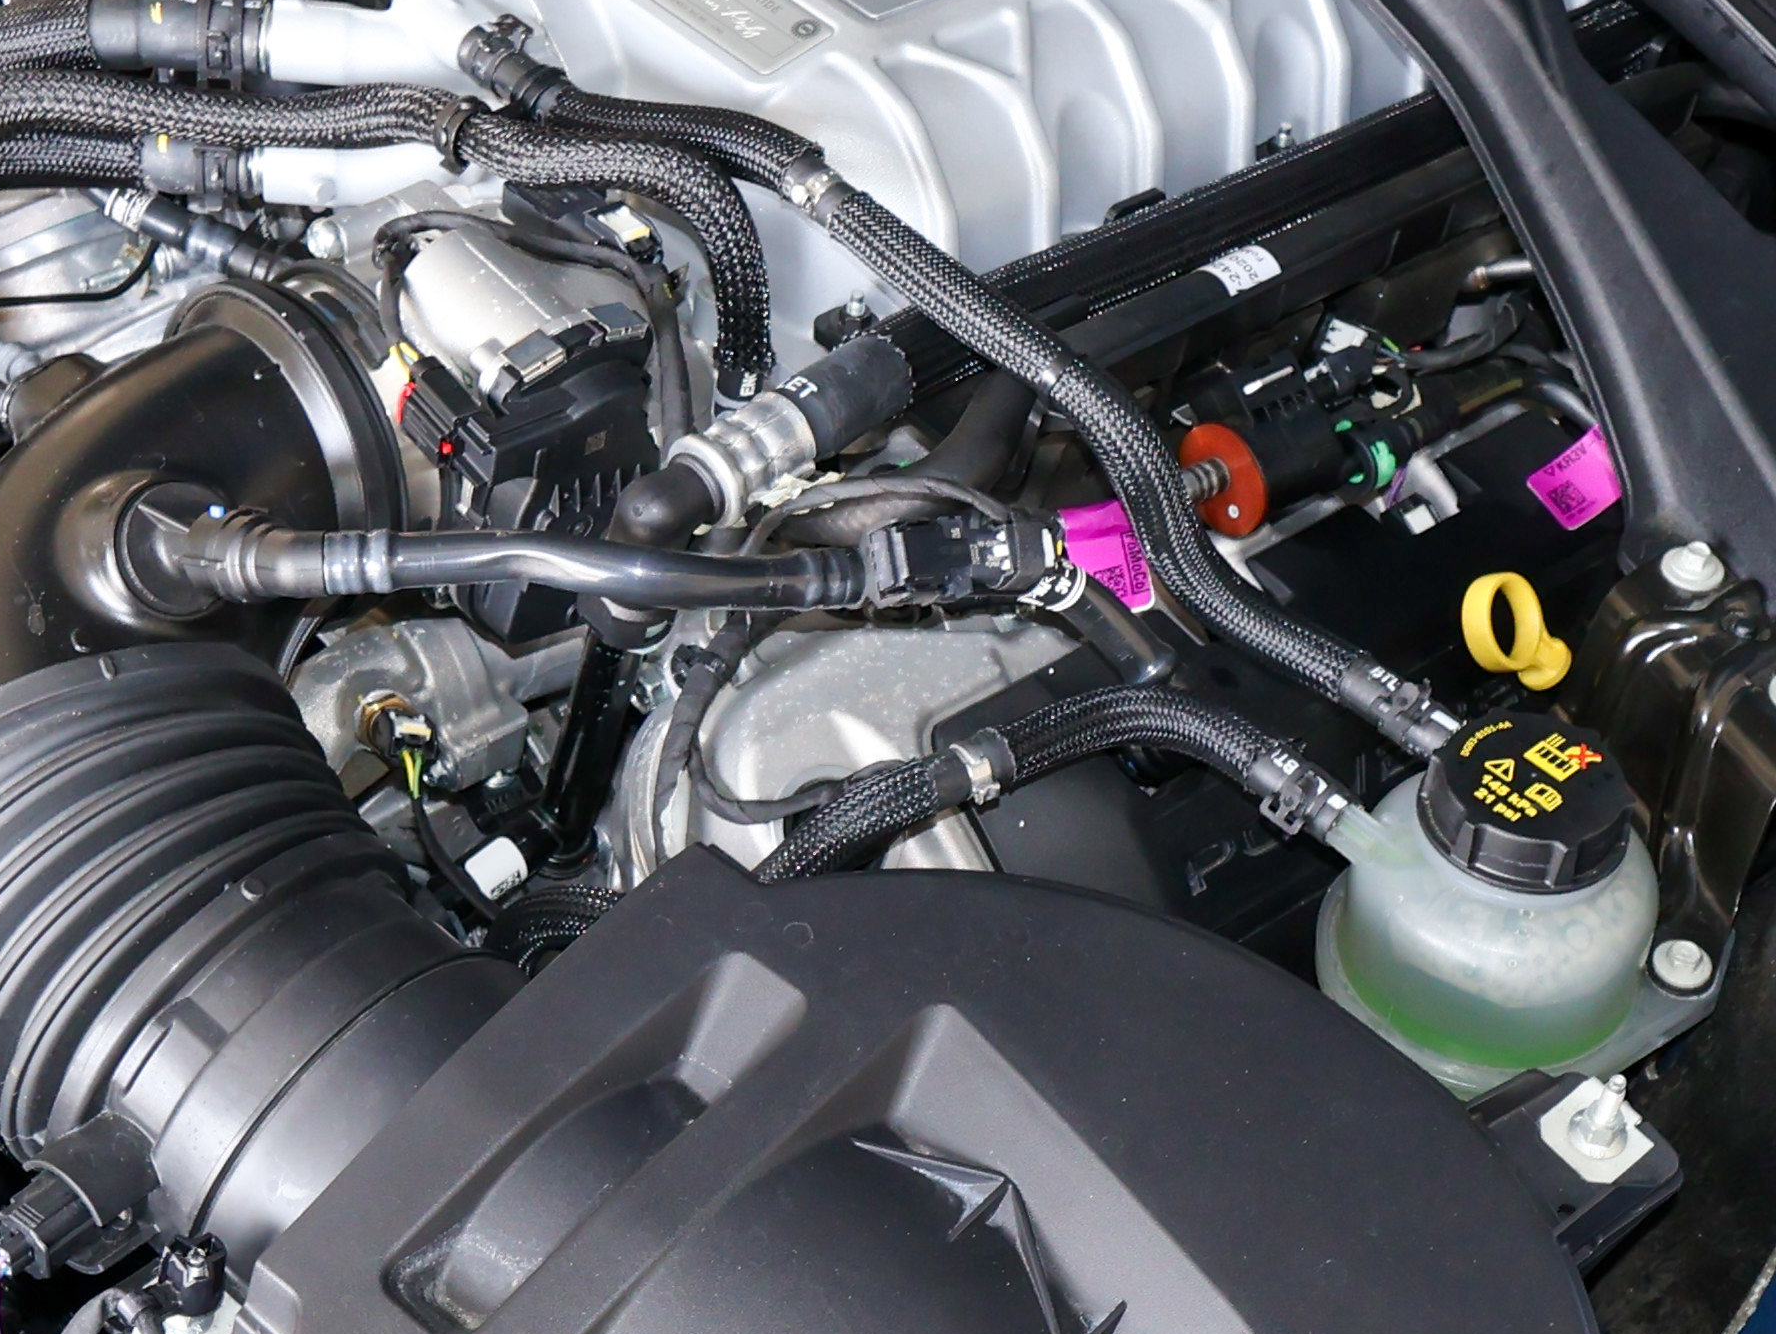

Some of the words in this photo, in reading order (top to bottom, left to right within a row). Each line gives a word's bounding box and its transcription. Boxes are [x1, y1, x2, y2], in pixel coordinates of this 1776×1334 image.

[1473, 786, 1497, 805] 21
[1492, 801, 1523, 823] psi
[1481, 773, 1511, 797] 145
[1507, 792, 1539, 818] kPa
